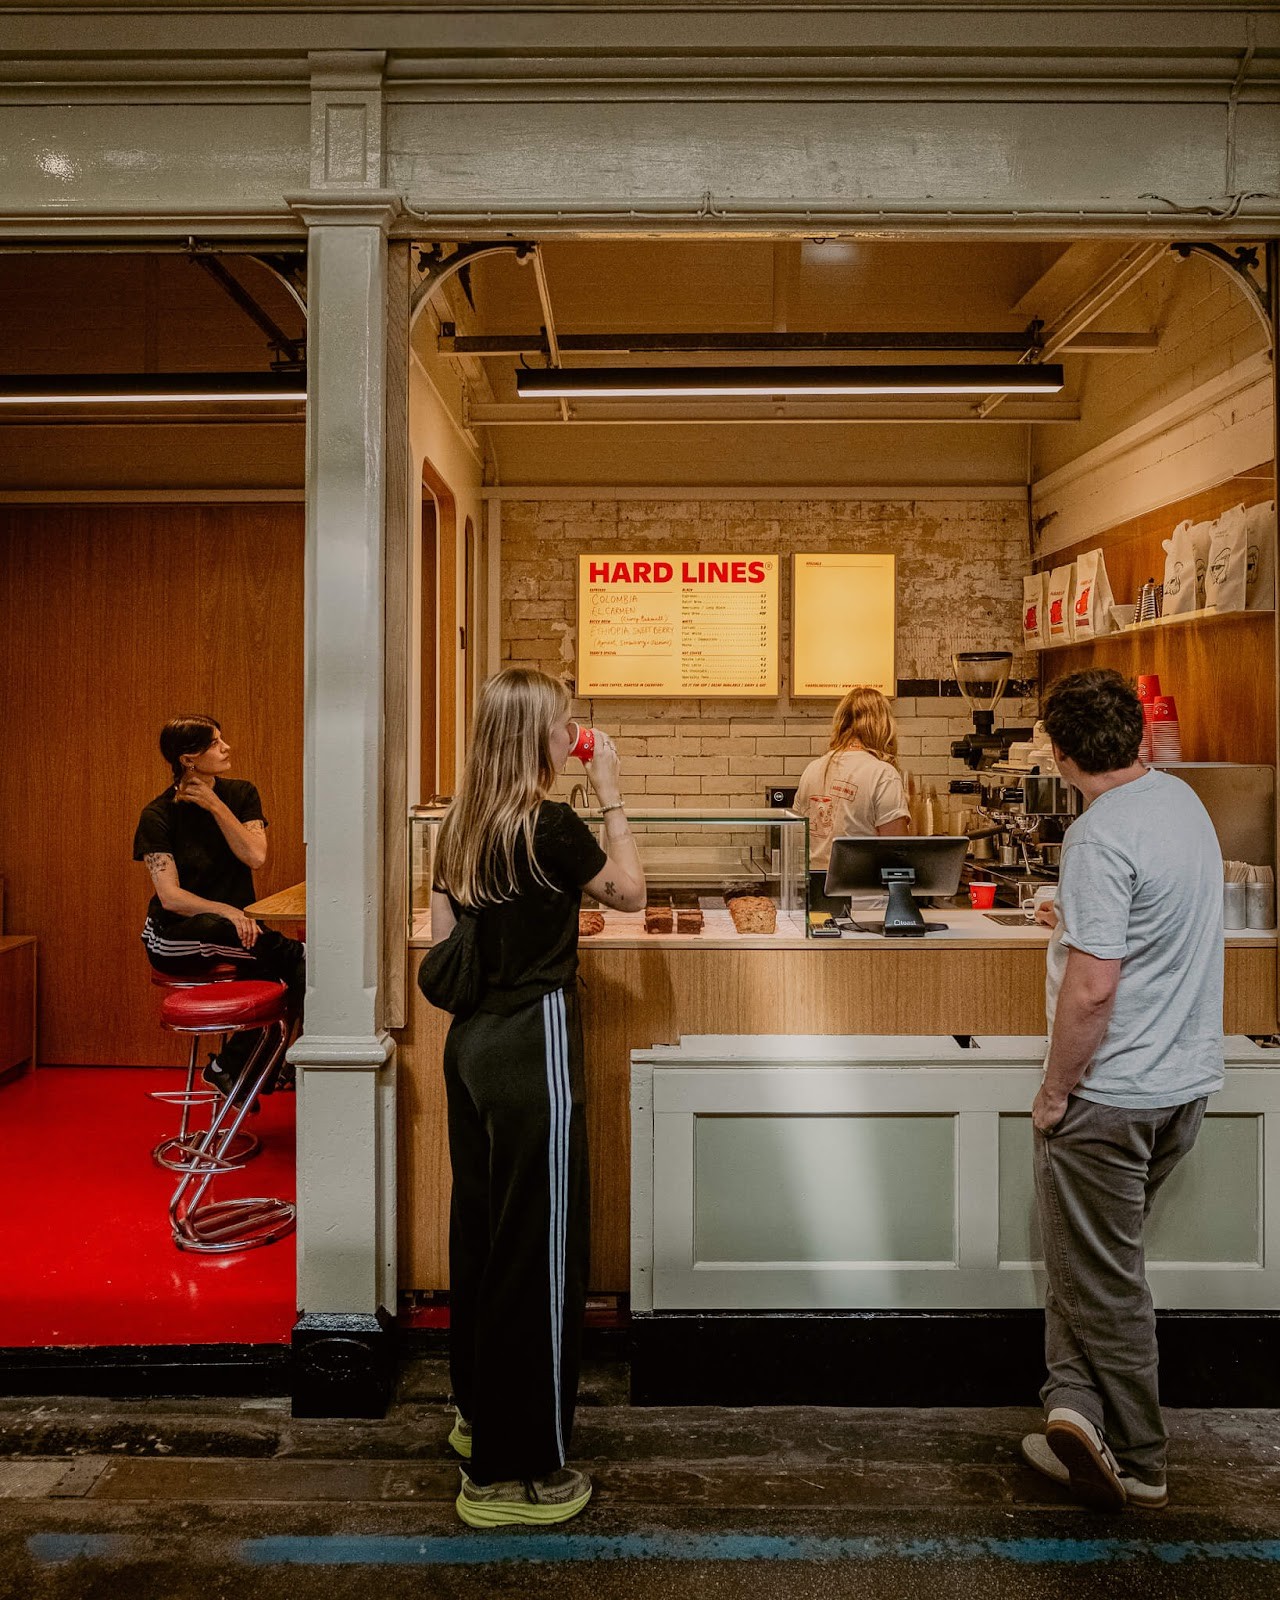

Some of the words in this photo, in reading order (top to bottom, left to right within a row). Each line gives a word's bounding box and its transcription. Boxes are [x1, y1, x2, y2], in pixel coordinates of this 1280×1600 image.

[589, 562, 674, 583] HARD
[591, 593, 638, 605] COLOMBIA
[605, 606, 636, 615] CARMEN
[590, 626, 630, 637] ETHIOPIA
